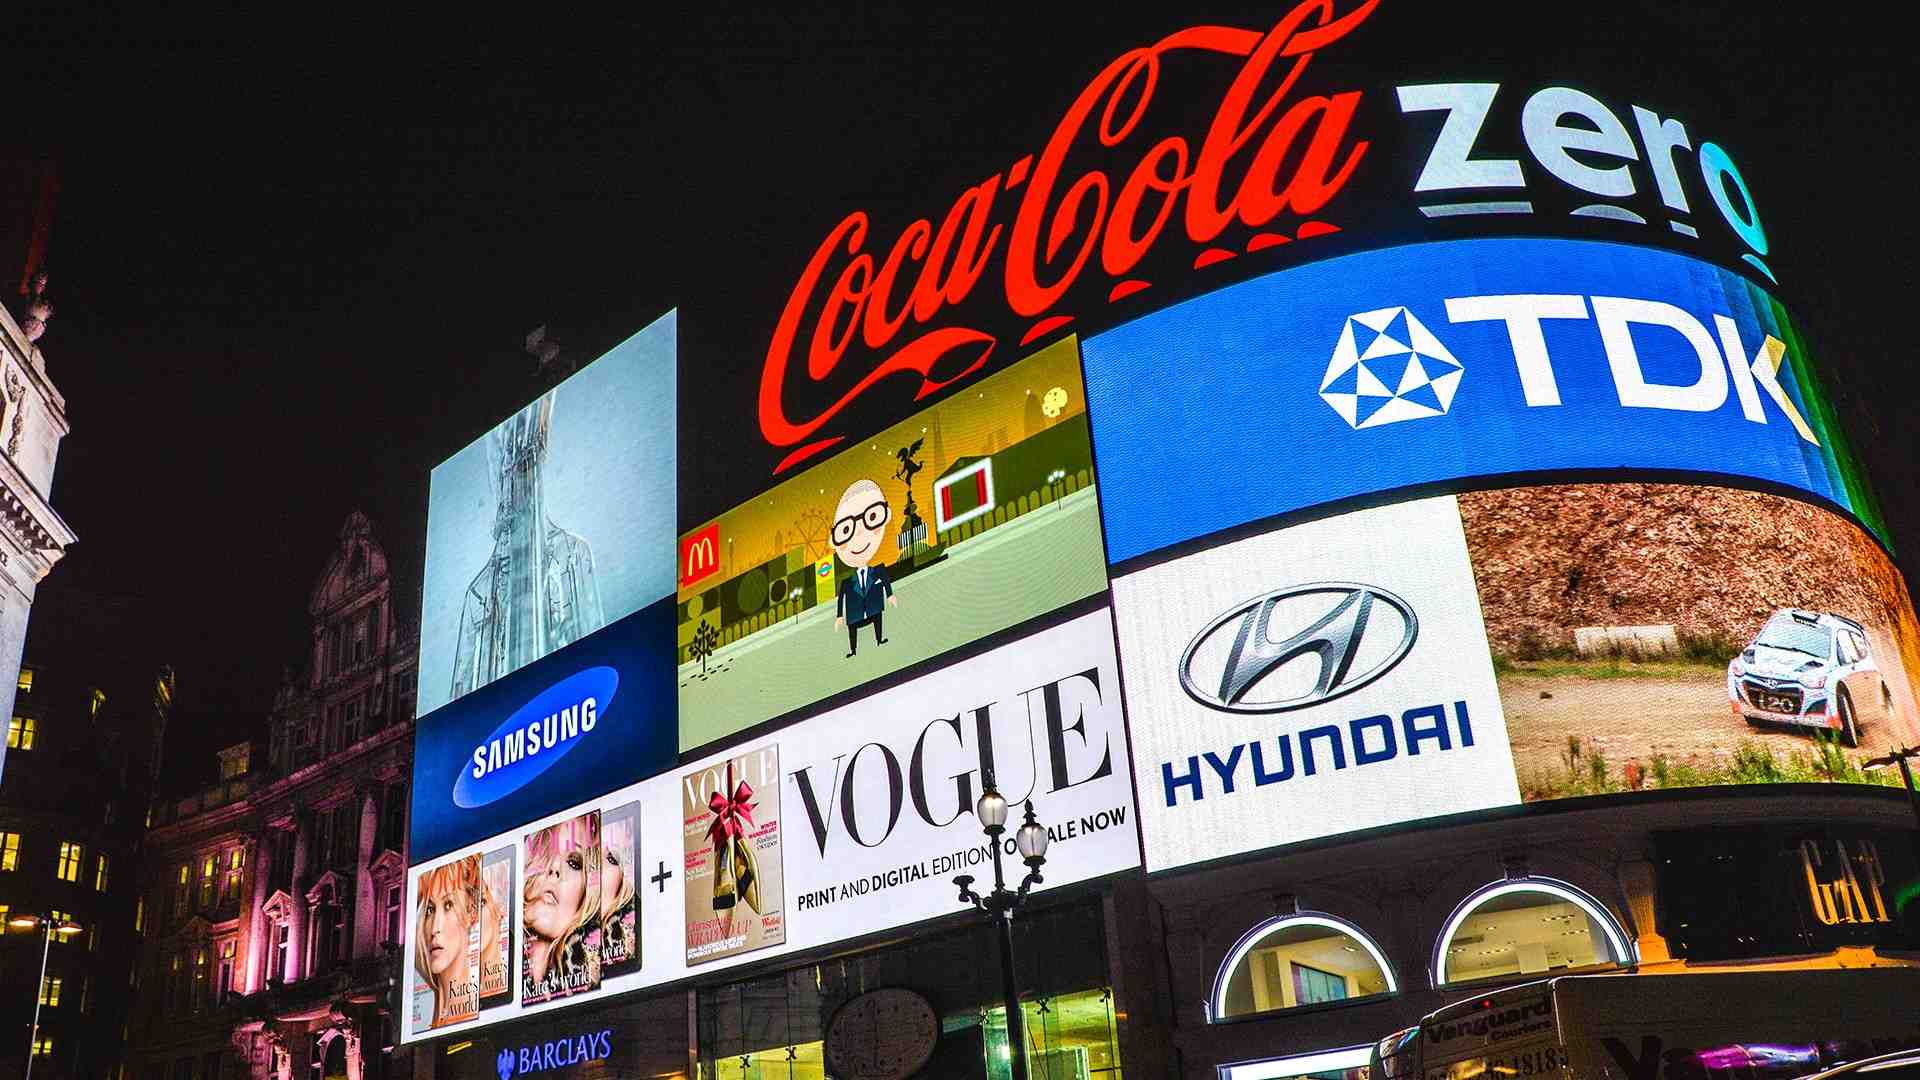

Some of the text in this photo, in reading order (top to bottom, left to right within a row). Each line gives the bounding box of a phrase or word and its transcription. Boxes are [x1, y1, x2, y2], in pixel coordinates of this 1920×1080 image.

[759, 0, 1768, 446] Coca-Cola zero
[1444, 294, 1821, 447] TDK
[472, 697, 597, 779] SAMSUNG
[788, 667, 1113, 860] VOGUE
[1161, 700, 1475, 807] HYUNDAI
[798, 887, 837, 911] PRINT
[840, 877, 870, 901] AND
[872, 862, 930, 892] DIGITAL
[932, 839, 1002, 876] EDITION
[1047, 820, 1077, 845] ALE
[1081, 806, 1127, 836] NOW
[1800, 839, 1890, 925] GAP
[449, 994, 478, 1016] world
[519, 1029, 612, 1074] BARCLAYS
